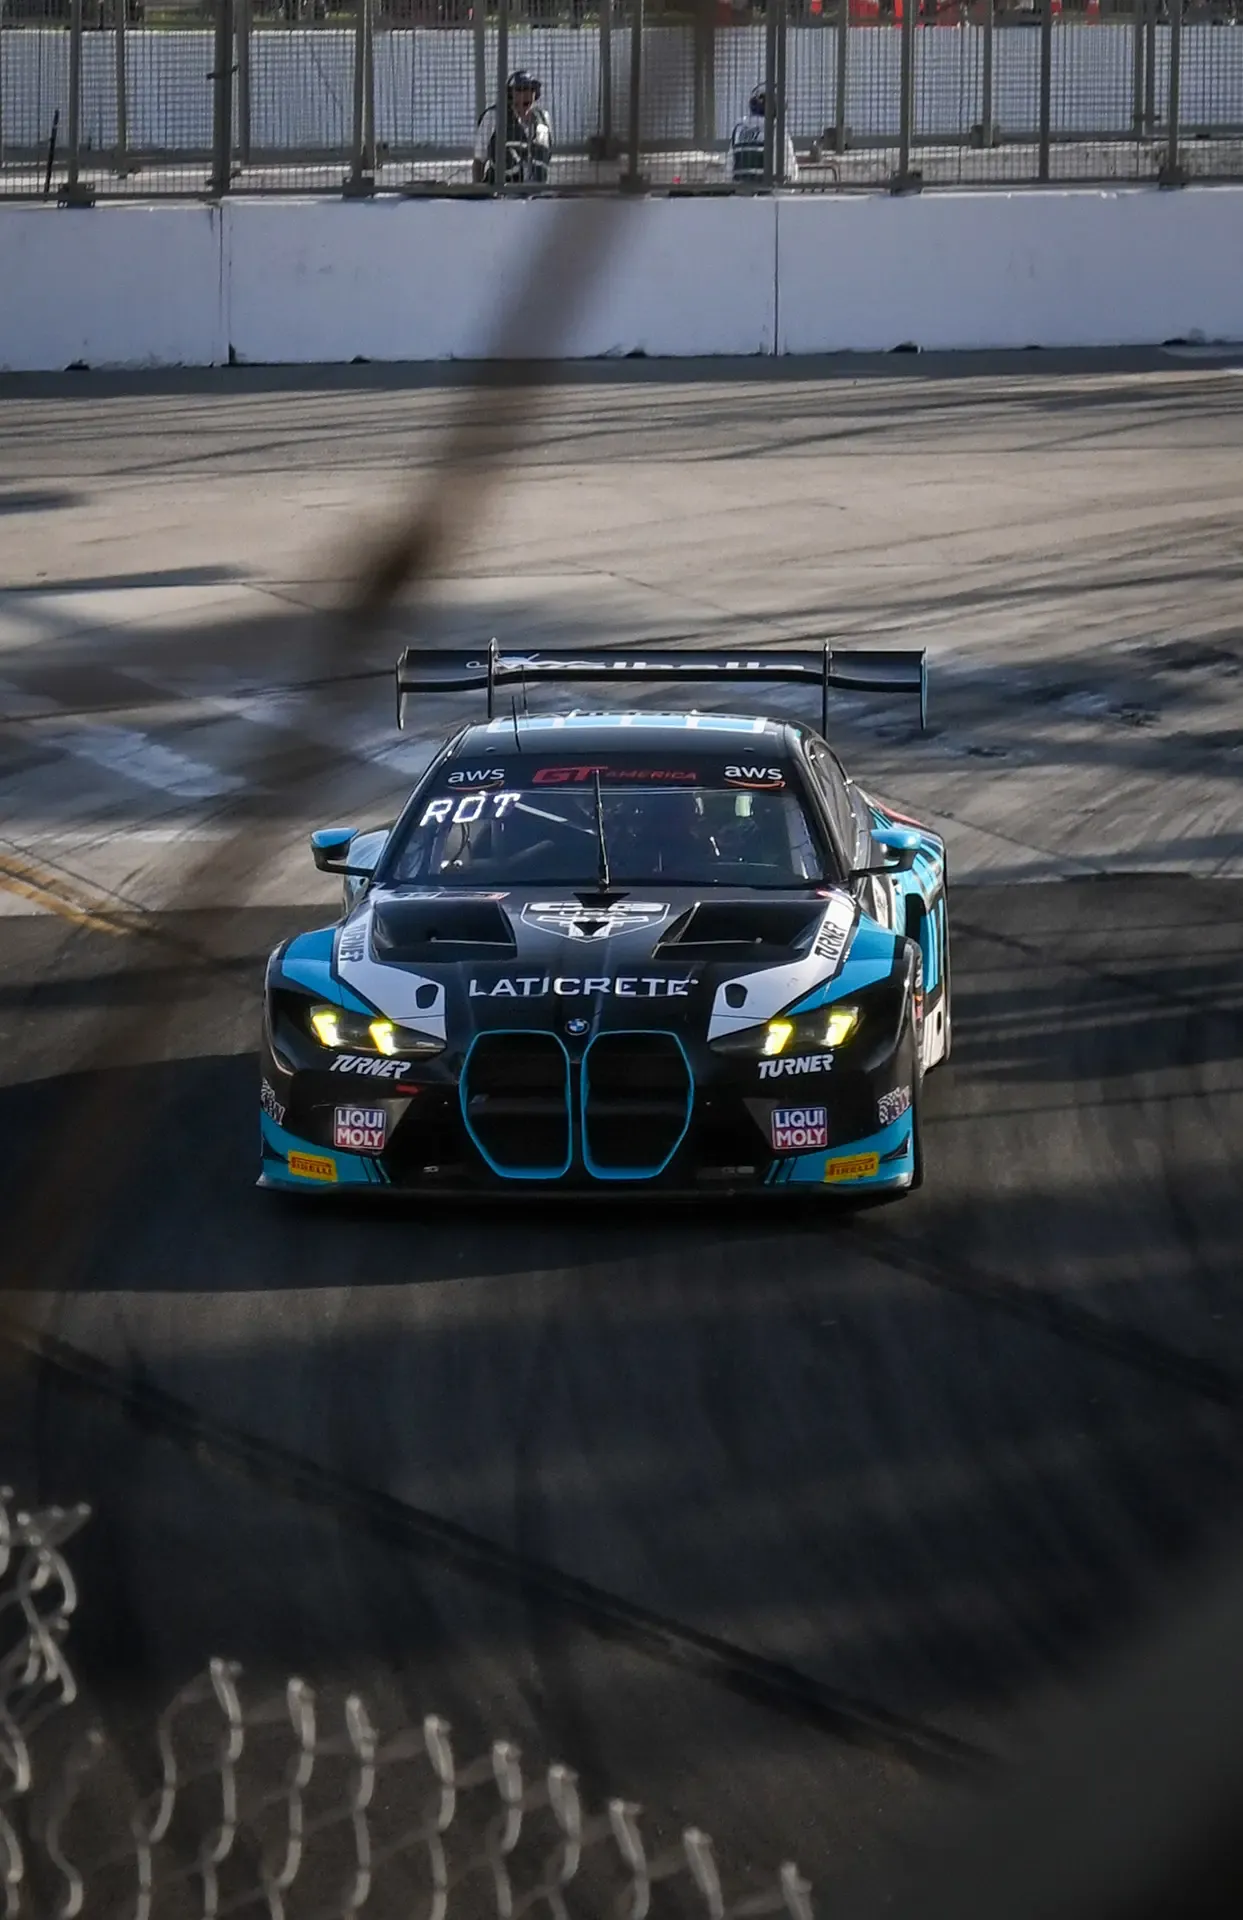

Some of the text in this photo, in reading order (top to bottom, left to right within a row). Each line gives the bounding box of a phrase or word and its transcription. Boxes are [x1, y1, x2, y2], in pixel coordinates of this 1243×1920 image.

[448, 768, 505, 783] aws
[532, 766, 697, 785] GT AMERICA
[725, 765, 783, 780] aws
[469, 977, 689, 996] LATICRETE
[329, 1054, 412, 1079] TURNER
[757, 1054, 835, 1079] TURNER
[336, 1109, 383, 1129] LIQUI
[775, 1109, 824, 1129] LIQUI
[336, 1128, 384, 1147] MOLY
[776, 1127, 826, 1146] MOLY
